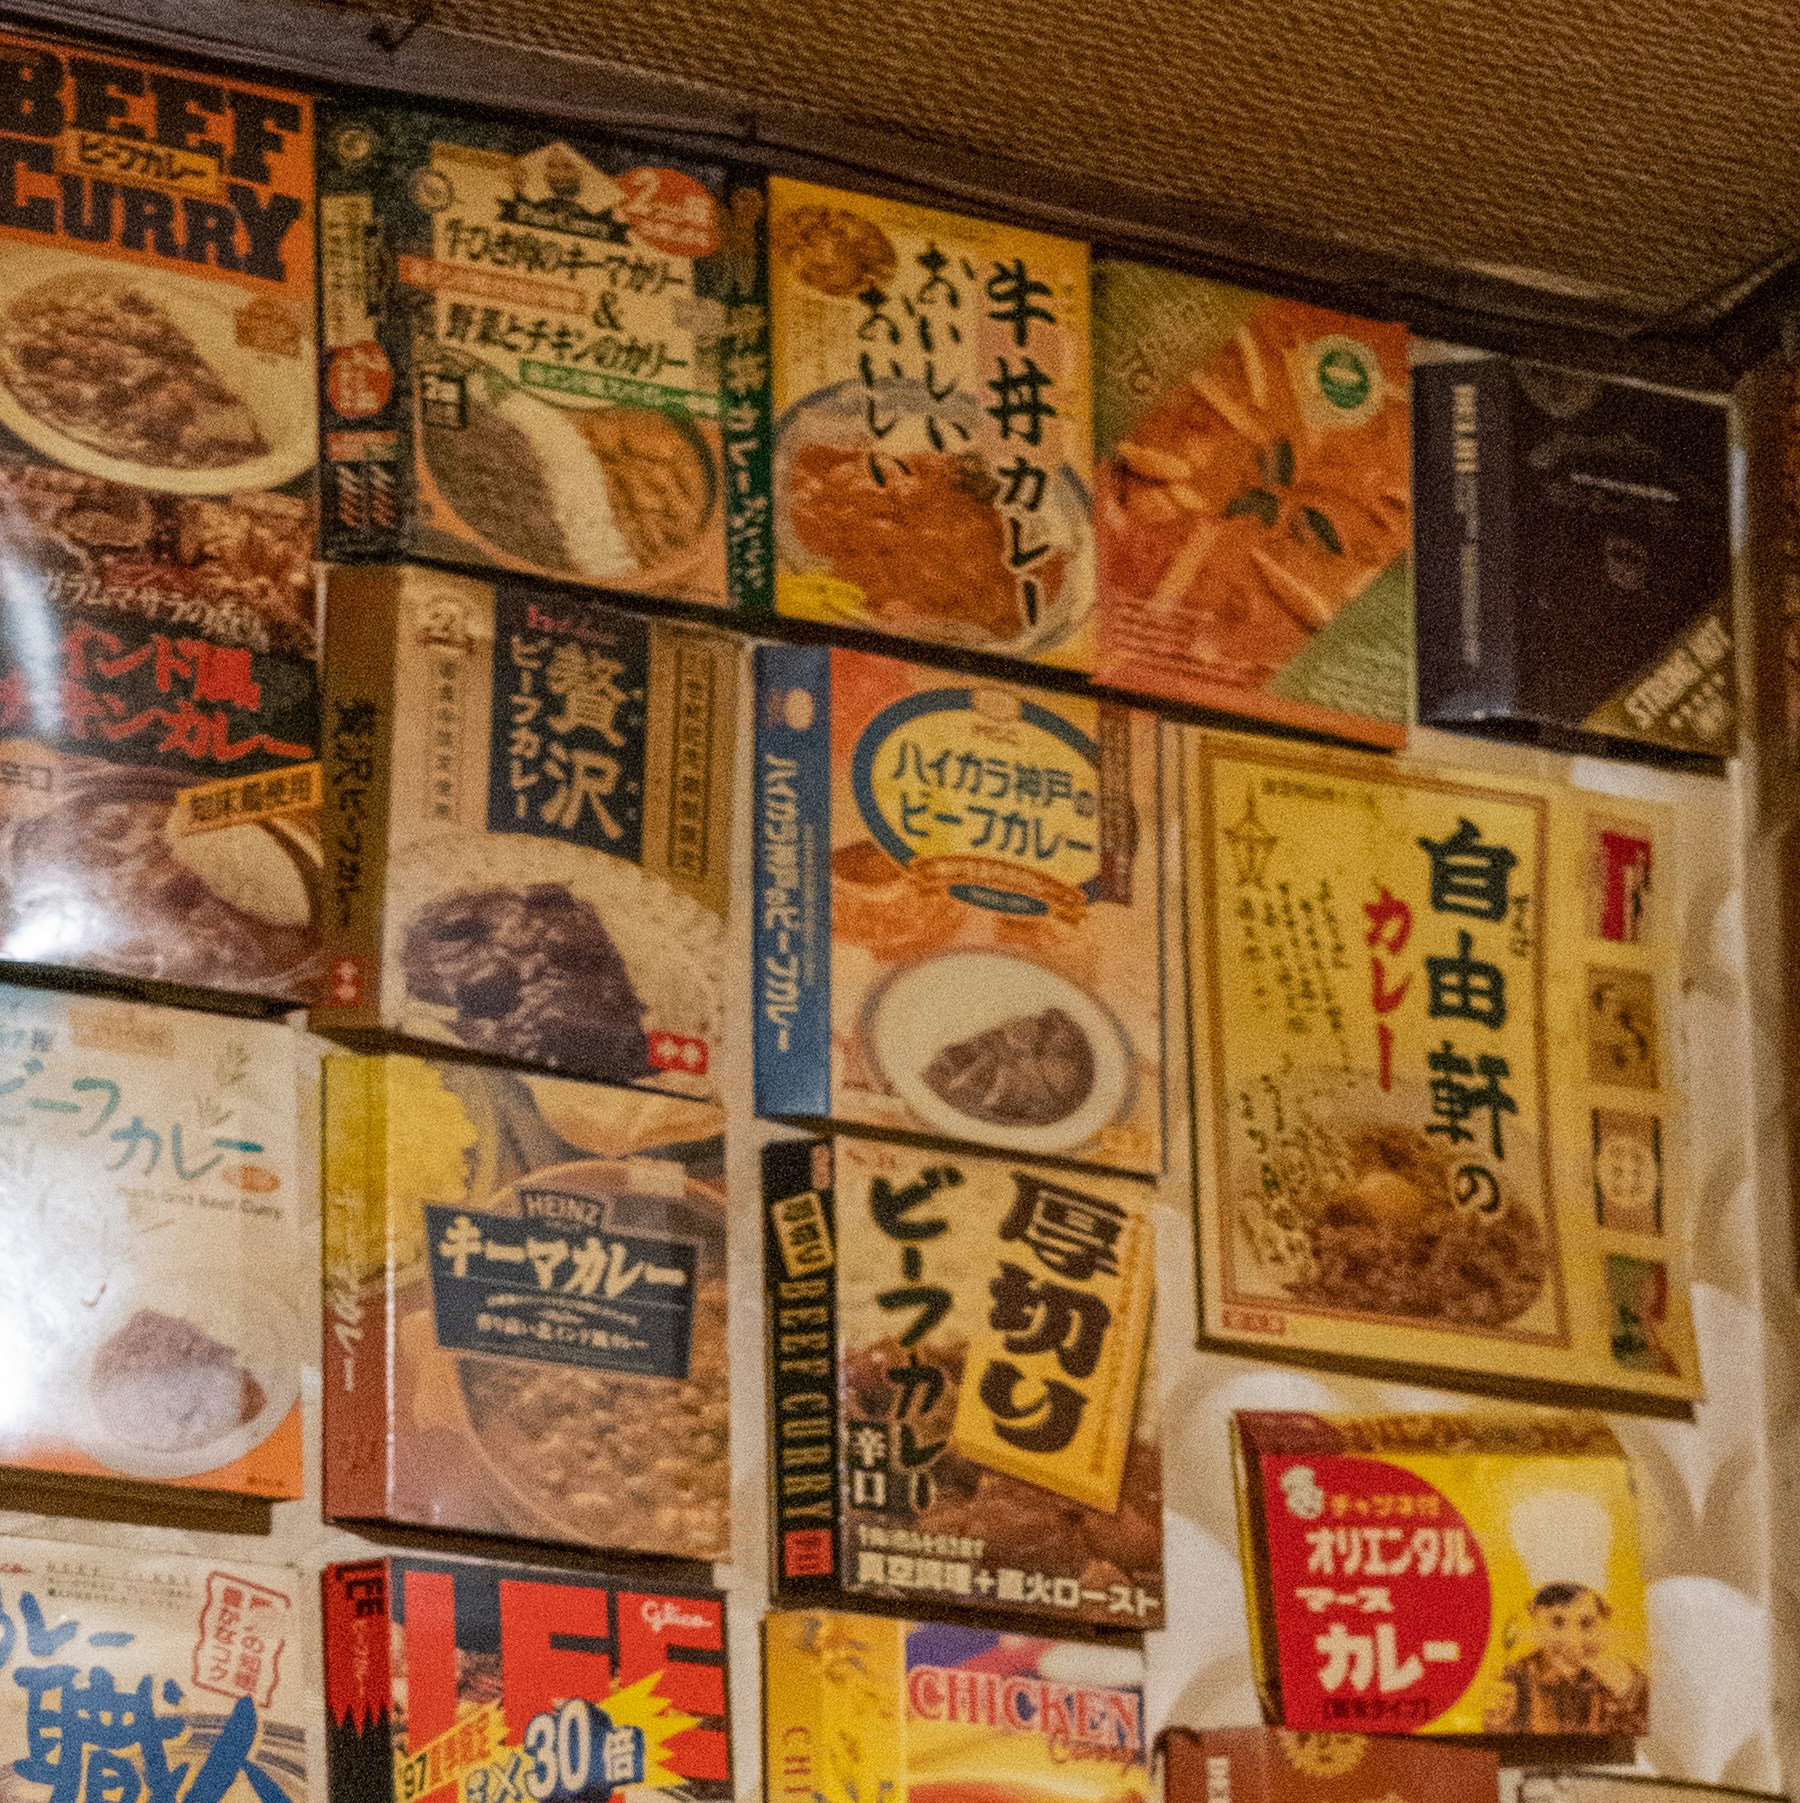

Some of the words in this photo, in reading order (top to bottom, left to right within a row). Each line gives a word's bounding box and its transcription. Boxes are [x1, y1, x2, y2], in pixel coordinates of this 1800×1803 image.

[77, 135, 210, 182] ビーフカレー
[859, 285, 911, 487] おいしい
[916, 243, 976, 451] おいしい
[987, 257, 1056, 625] 牛丼カレー
[63, 620, 261, 712] インド風
[510, 635, 541, 818] ビーフカレー
[541, 642, 624, 839] 贅沢
[892, 740, 1095, 818] ハイカラ神戸の
[900, 791, 1093, 859] ビーフカレー
[1364, 886, 1413, 1093] カレー
[1417, 818, 1518, 1217] 自由軒の
[439, 1215, 686, 1298] キーマカレー
[526, 1194, 598, 1229] HEINZ
[779, 1281, 830, 1377] BEEF
[870, 1164, 964, 1511] ビーフカレー
[980, 1169, 1129, 1455] 厚切り
[781, 1391, 832, 1520] CURRY
[854, 1427, 887, 1506] 辛口
[336, 1566, 383, 1617] LEE
[1305, 1527, 1474, 1576] オリエンタル
[1296, 1586, 1394, 1612] マース
[1315, 1623, 1460, 1693] カレー
[908, 1667, 1143, 1748] CHICKEN
